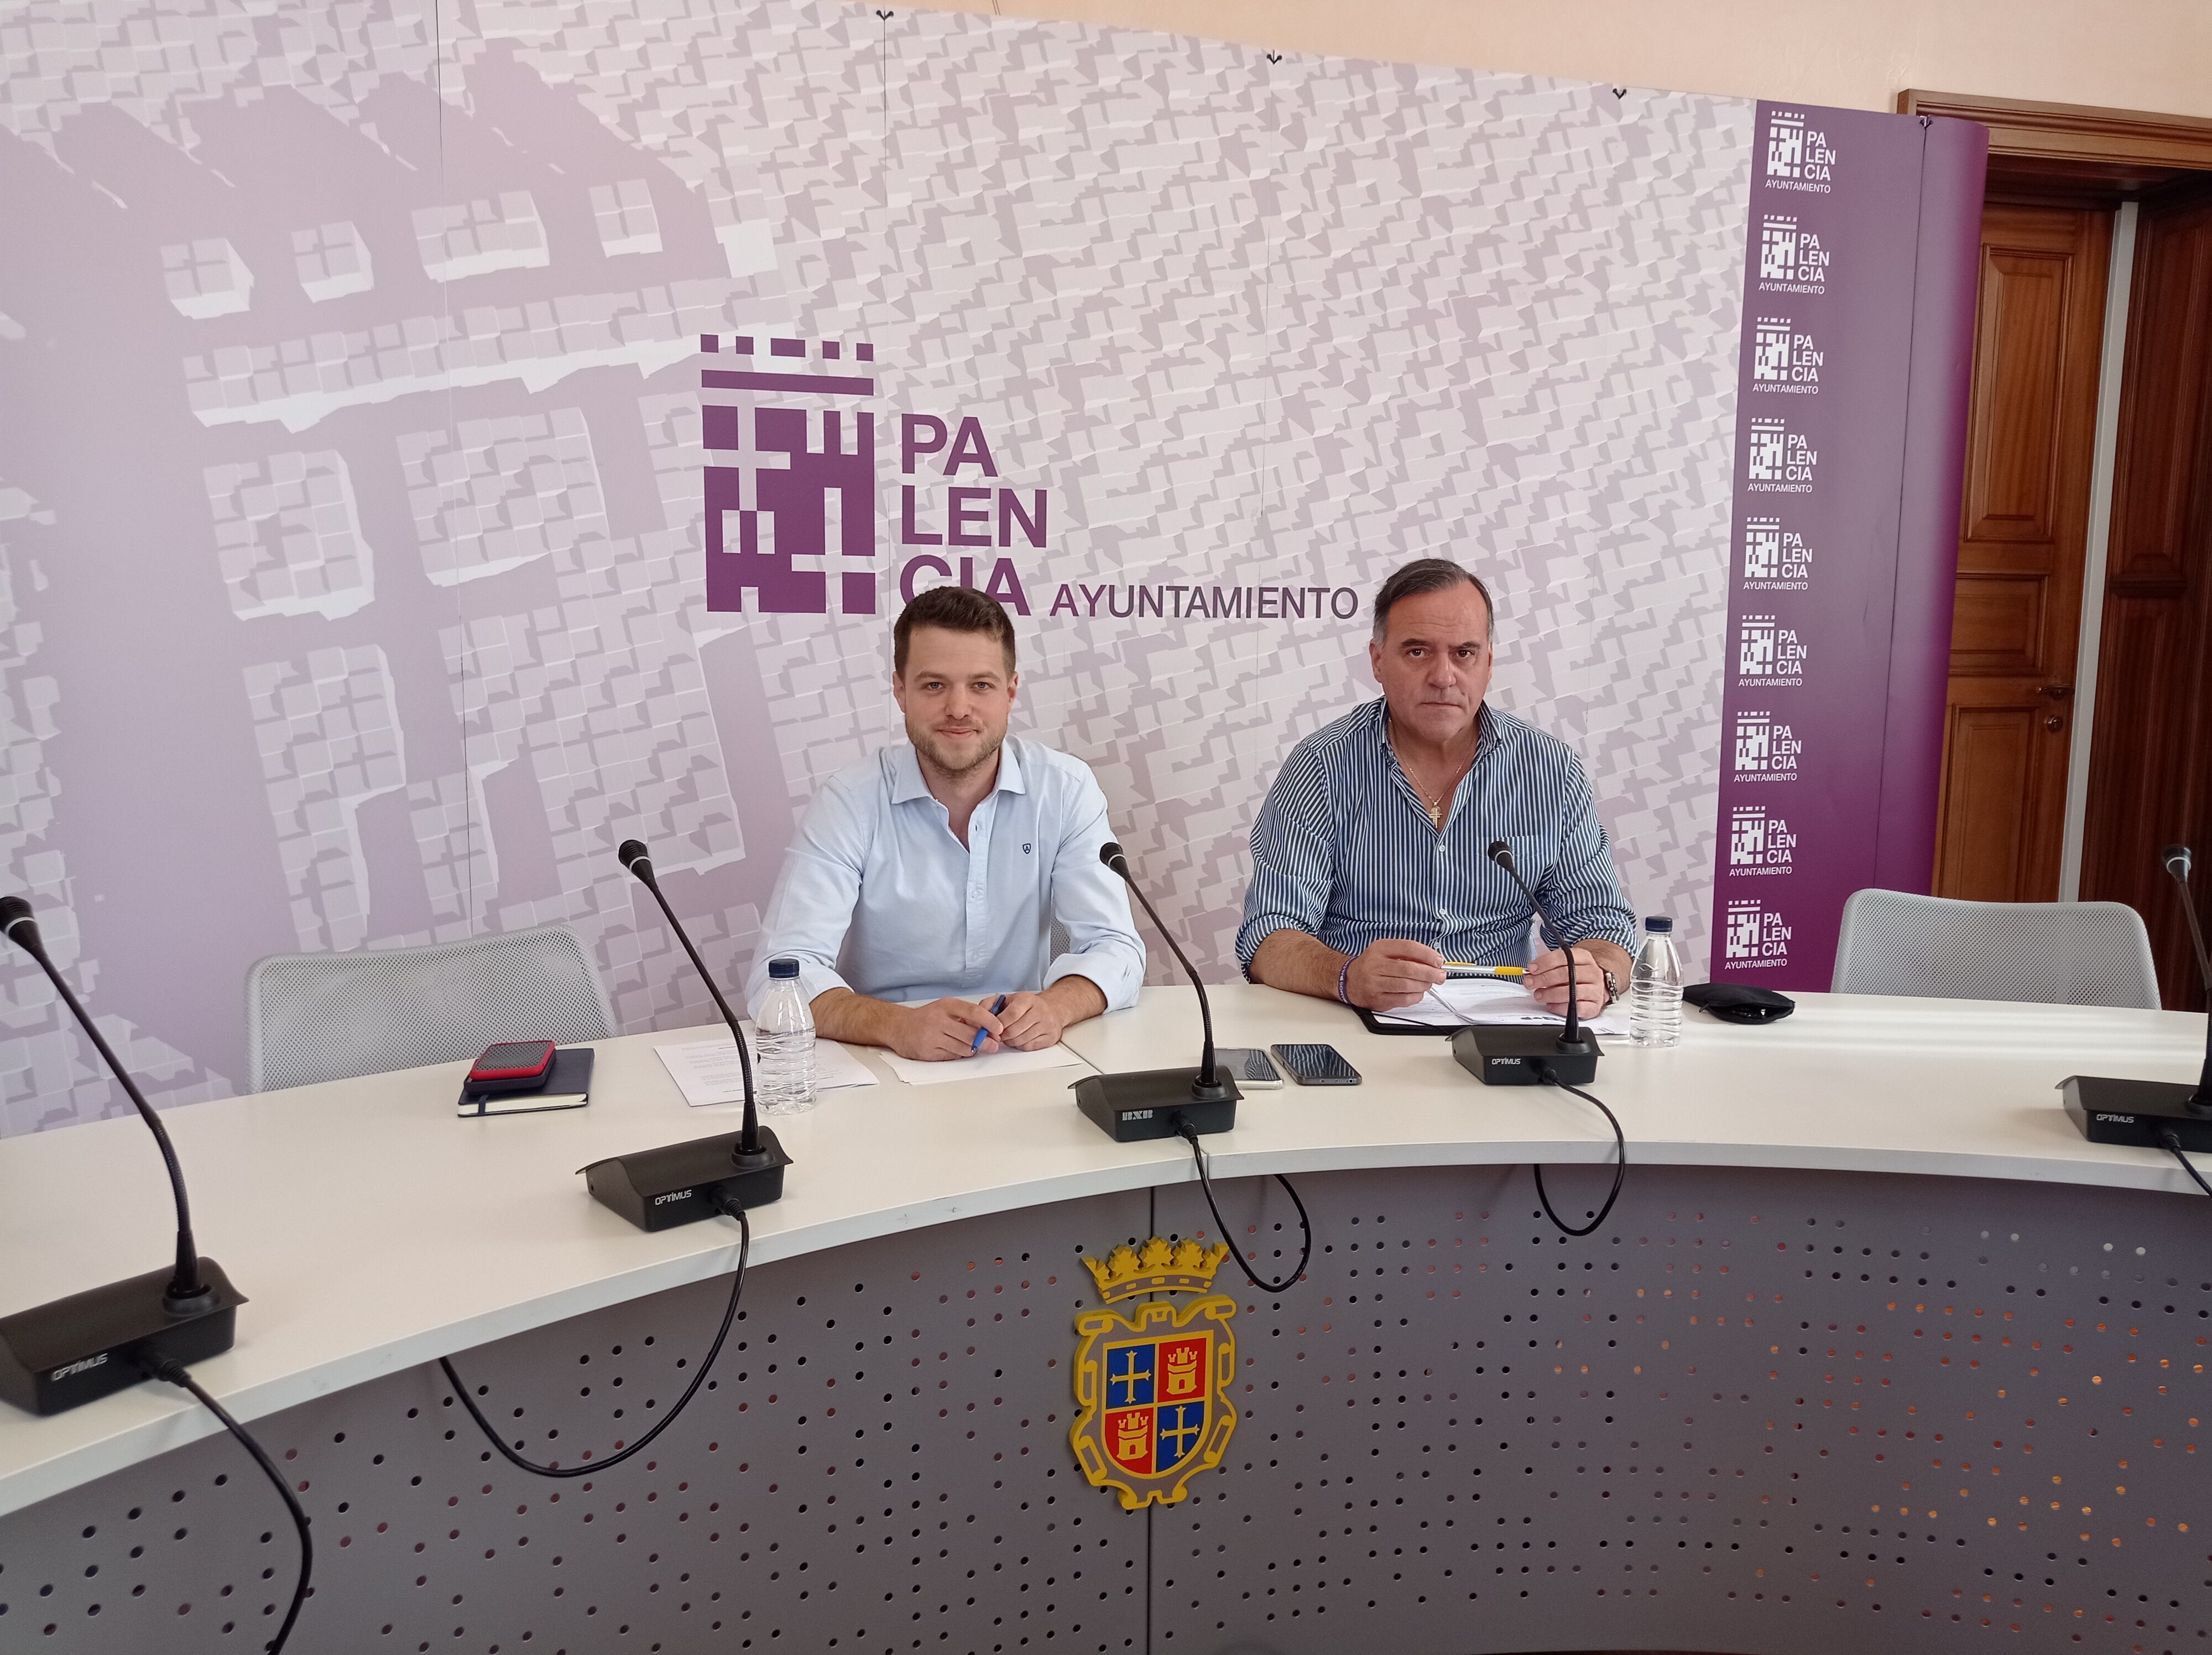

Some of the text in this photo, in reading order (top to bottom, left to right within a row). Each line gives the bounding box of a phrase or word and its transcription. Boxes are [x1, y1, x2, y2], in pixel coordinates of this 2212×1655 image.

[1807, 131, 1827, 148] PA
[1805, 147, 1836, 165] LEN
[1804, 164, 1831, 181] CIA
[1765, 179, 1831, 194] AYUNTAMIENTO
[1800, 233, 1820, 249] PA
[1799, 249, 1830, 266] LEN
[1798, 266, 1825, 282] CIA
[1759, 282, 1825, 294] AYUNTAMIENTO
[1793, 334, 1814, 350] PA
[1792, 350, 1824, 366] LEN
[1791, 366, 1819, 382] CIA
[1752, 383, 1819, 394] AYUNTAMIENTO
[902, 414, 998, 477] PA
[1787, 434, 1808, 449] PA
[1787, 450, 1817, 465] LEN
[1786, 466, 1813, 481] CIA
[1747, 483, 1813, 493] AYUNTAMIENTO
[902, 485, 1047, 548] LEN
[1783, 532, 1803, 547] PA
[1782, 548, 1813, 563] LEN
[1781, 564, 1808, 578] CIA
[1743, 581, 1808, 590] AYUNTAMIENTO
[1050, 584, 1358, 619] AYUNTAMIENTO
[1778, 629, 1798, 644] PA
[1777, 645, 1807, 659] LEN
[1776, 660, 1802, 675] CIA
[1738, 678, 1802, 686] AYUNTAMIENTO
[1773, 725, 1792, 740] PA
[1772, 740, 1802, 754] LEN
[1771, 756, 1797, 770] CIA
[1734, 773, 1797, 782] AYUNTAMIENTO
[1768, 820, 1787, 834] PA
[1767, 834, 1796, 849] LEN
[1767, 849, 1792, 863] CIA
[1729, 866, 1792, 876] AYUNTAMIENTO
[1764, 913, 1782, 927] PA
[1763, 927, 1791, 941] LEN
[1762, 941, 1787, 956] CIA
[1725, 959, 1787, 970] AYUNTAMIENTO
[2096, 1113, 2135, 1123] OPTIMUS
[655, 1189, 692, 1205] OPTIMUS
